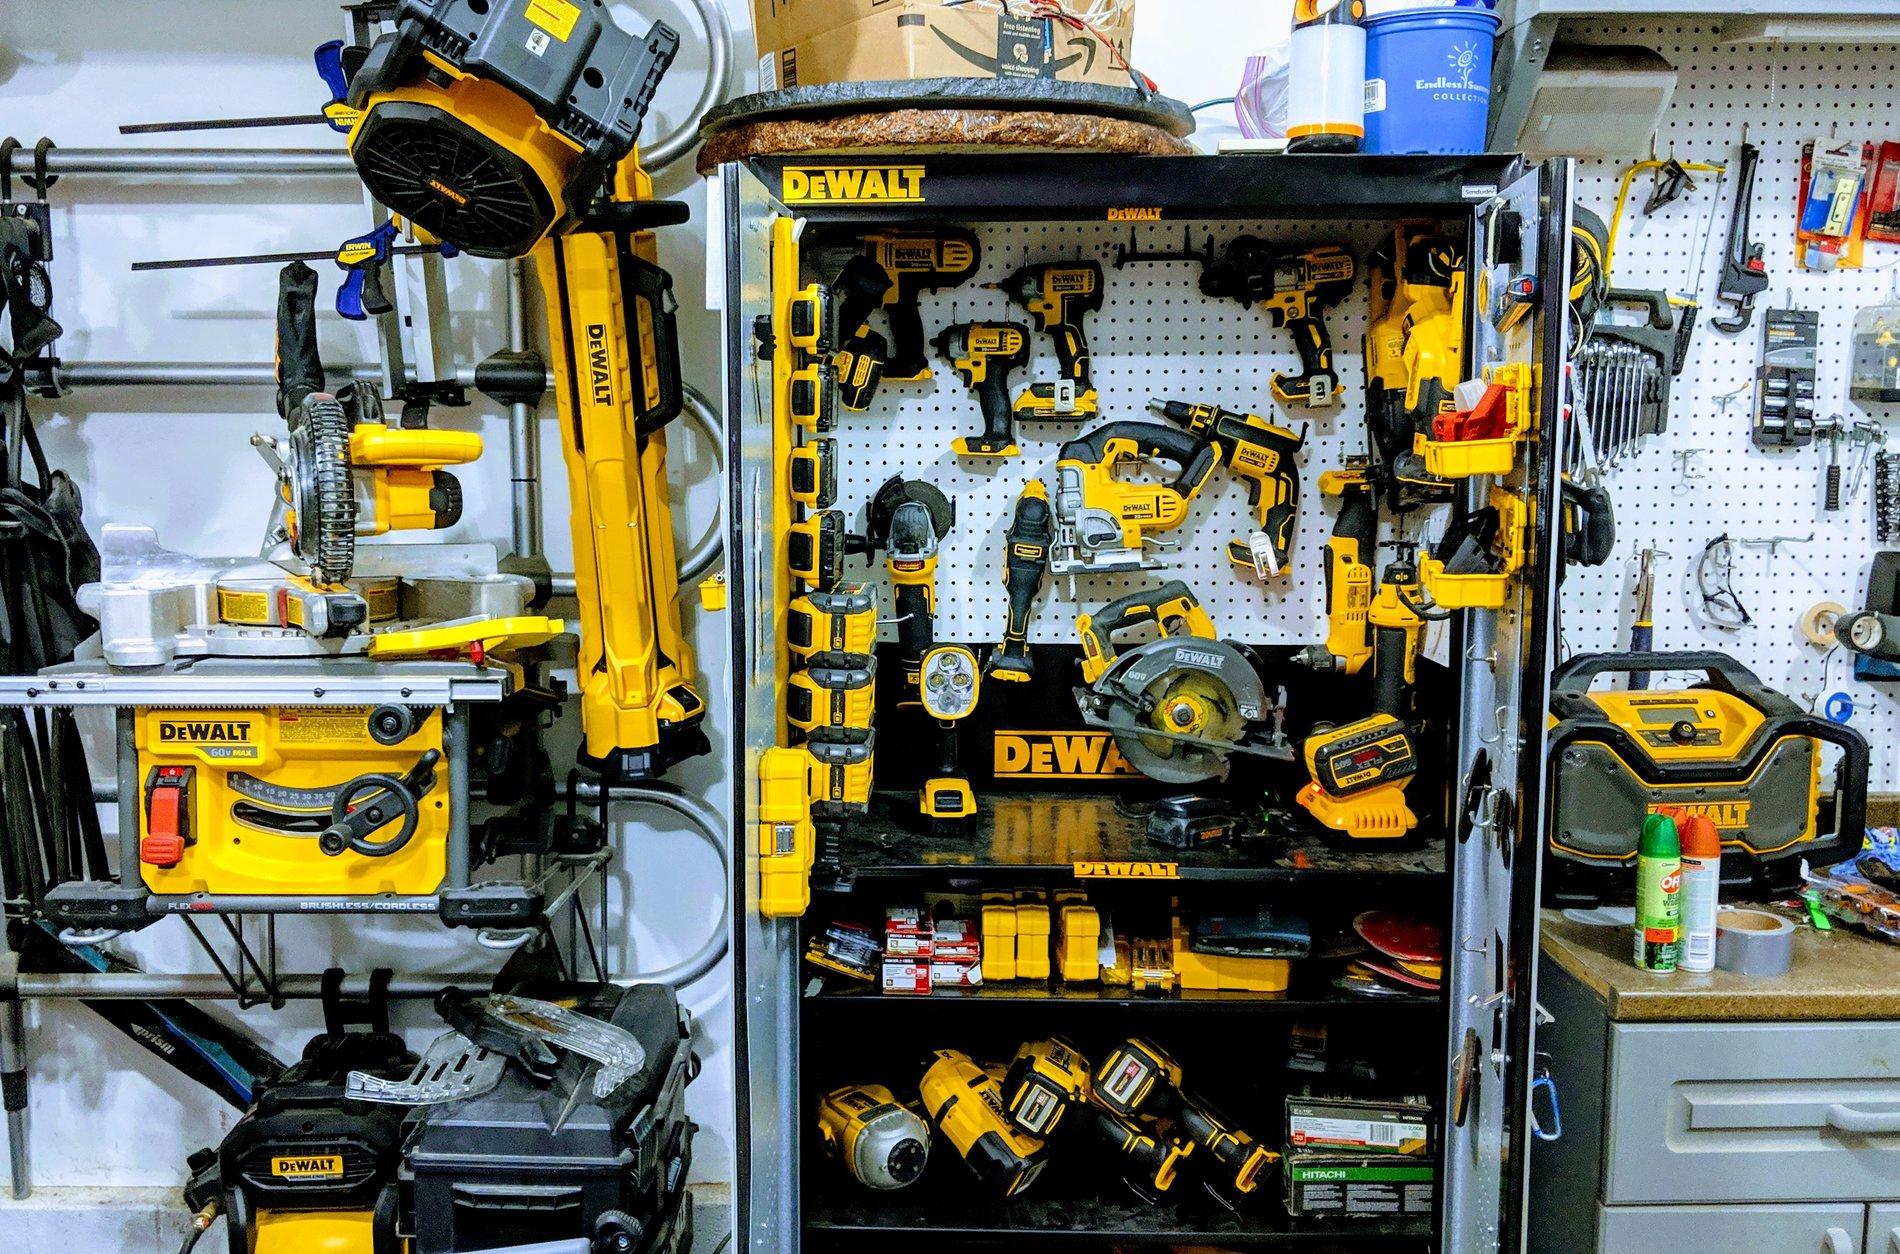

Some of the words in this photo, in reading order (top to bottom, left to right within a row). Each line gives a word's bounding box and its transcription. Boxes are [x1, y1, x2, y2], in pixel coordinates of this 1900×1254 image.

[1416, 77, 1462, 90] Endless
[783, 167, 926, 201] DEWALT
[1107, 207, 1162, 221] DEWALT
[345, 242, 371, 251] IRWIN
[1052, 274, 1085, 283] DEWALT
[588, 324, 612, 407] DEWALT
[1241, 447, 1269, 461] DEWALT
[1123, 503, 1151, 511] DEWALT
[1174, 649, 1225, 668] DEWALT
[160, 723, 251, 741] DEWALT
[1345, 771, 1372, 785] DEWALT
[290, 792, 300, 800] 25
[326, 791, 336, 799] 40
[1073, 862, 1179, 878] DEWALT
[300, 902, 436, 910] BRUSHLESS/CORDLESS
[135, 1027, 176, 1055] prism
[279, 1158, 335, 1172] DEWALT
[1302, 1170, 1346, 1179] HITACHI
